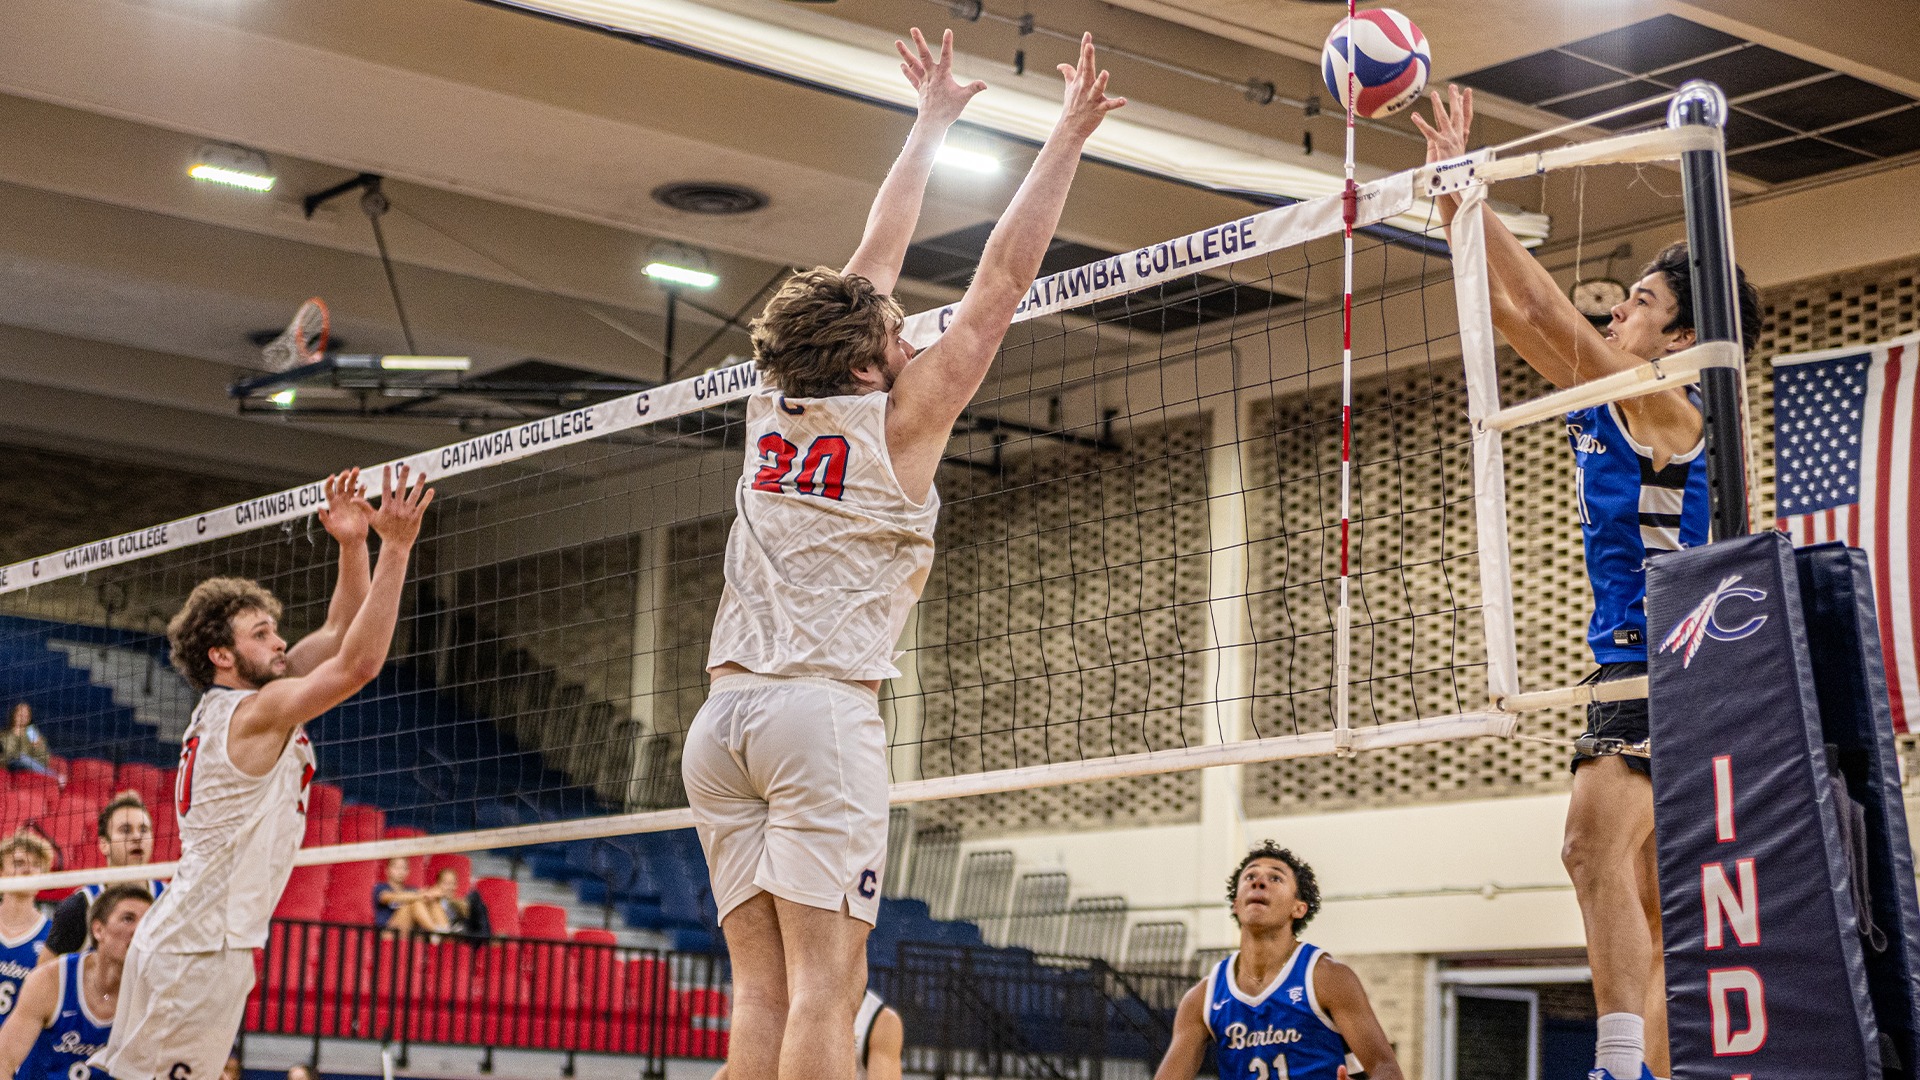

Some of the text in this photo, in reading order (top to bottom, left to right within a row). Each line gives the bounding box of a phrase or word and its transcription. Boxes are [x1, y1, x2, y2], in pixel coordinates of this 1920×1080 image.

[1016, 217, 1257, 314] ATAWBA COLLEGE
[693, 363, 758, 401] CATAW
[636, 393, 650, 416] C
[441, 408, 594, 469] CATAWBA COLLEGE
[751, 431, 851, 501] 20
[196, 516, 206, 535] C
[235, 492, 295, 525] CATAWBA
[64, 526, 168, 569] CATAWBA COLLEGE
[32, 560, 39, 578] C
[858, 868, 878, 900] C
[1700, 754, 1769, 1080] IND
[1225, 1021, 1303, 1050] Barton
